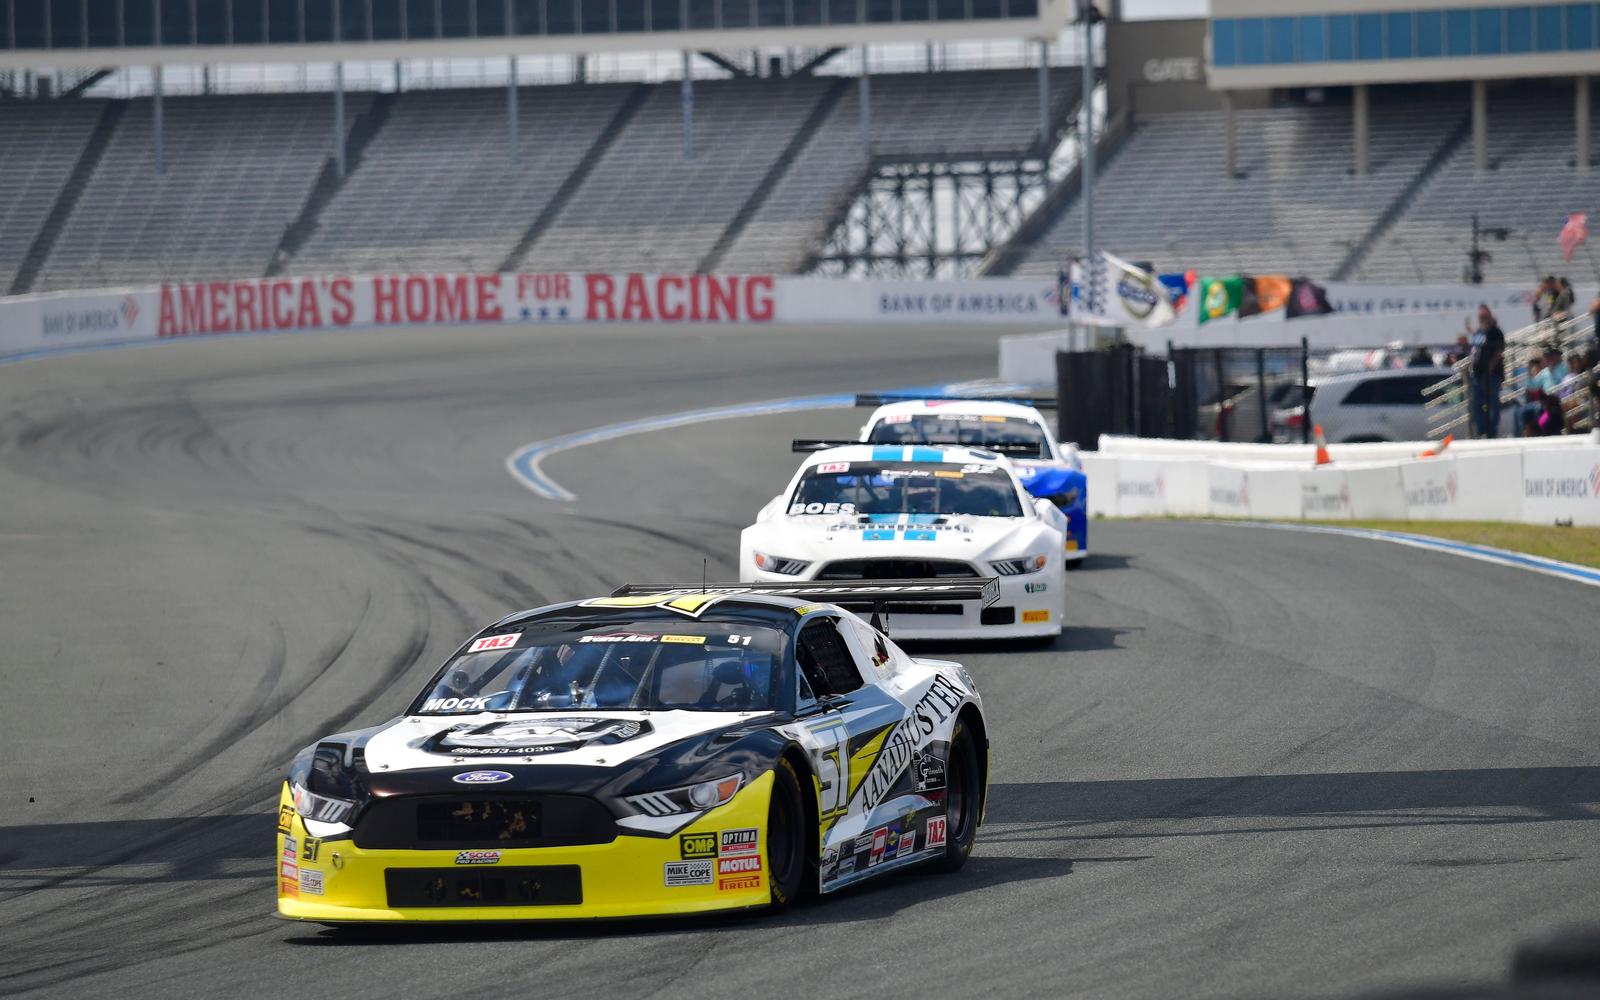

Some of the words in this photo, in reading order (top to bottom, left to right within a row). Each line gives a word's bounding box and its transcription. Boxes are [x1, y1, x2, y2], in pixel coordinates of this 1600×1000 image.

[1144, 57, 1199, 82] GATE
[158, 277, 355, 337] AMERICA'S
[372, 273, 502, 323] HOME
[516, 272, 571, 300] FOR
[585, 272, 775, 322] RACING
[880, 293, 924, 313] BANK
[931, 293, 951, 313] OF
[958, 292, 1038, 313] AMERICA
[822, 464, 846, 472] TA2
[1525, 478, 1544, 497] BANK
[1546, 478, 1555, 496] OF
[1556, 479, 1588, 497] AMERICA
[789, 502, 856, 515] BOES
[477, 634, 515, 650] TA2
[727, 634, 752, 646] 51
[421, 697, 492, 712] MOCK
[465, 772, 499, 782] Ford
[810, 730, 849, 818] 51
[723, 831, 756, 844] OPTIMA
[928, 819, 945, 844] TA2
[303, 837, 320, 861] 51
[684, 838, 715, 853] OMP
[667, 867, 688, 875] MIKE
[720, 857, 760, 873] MOTUL
[689, 868, 711, 878] COPE
[719, 876, 760, 891] PIRELLI
